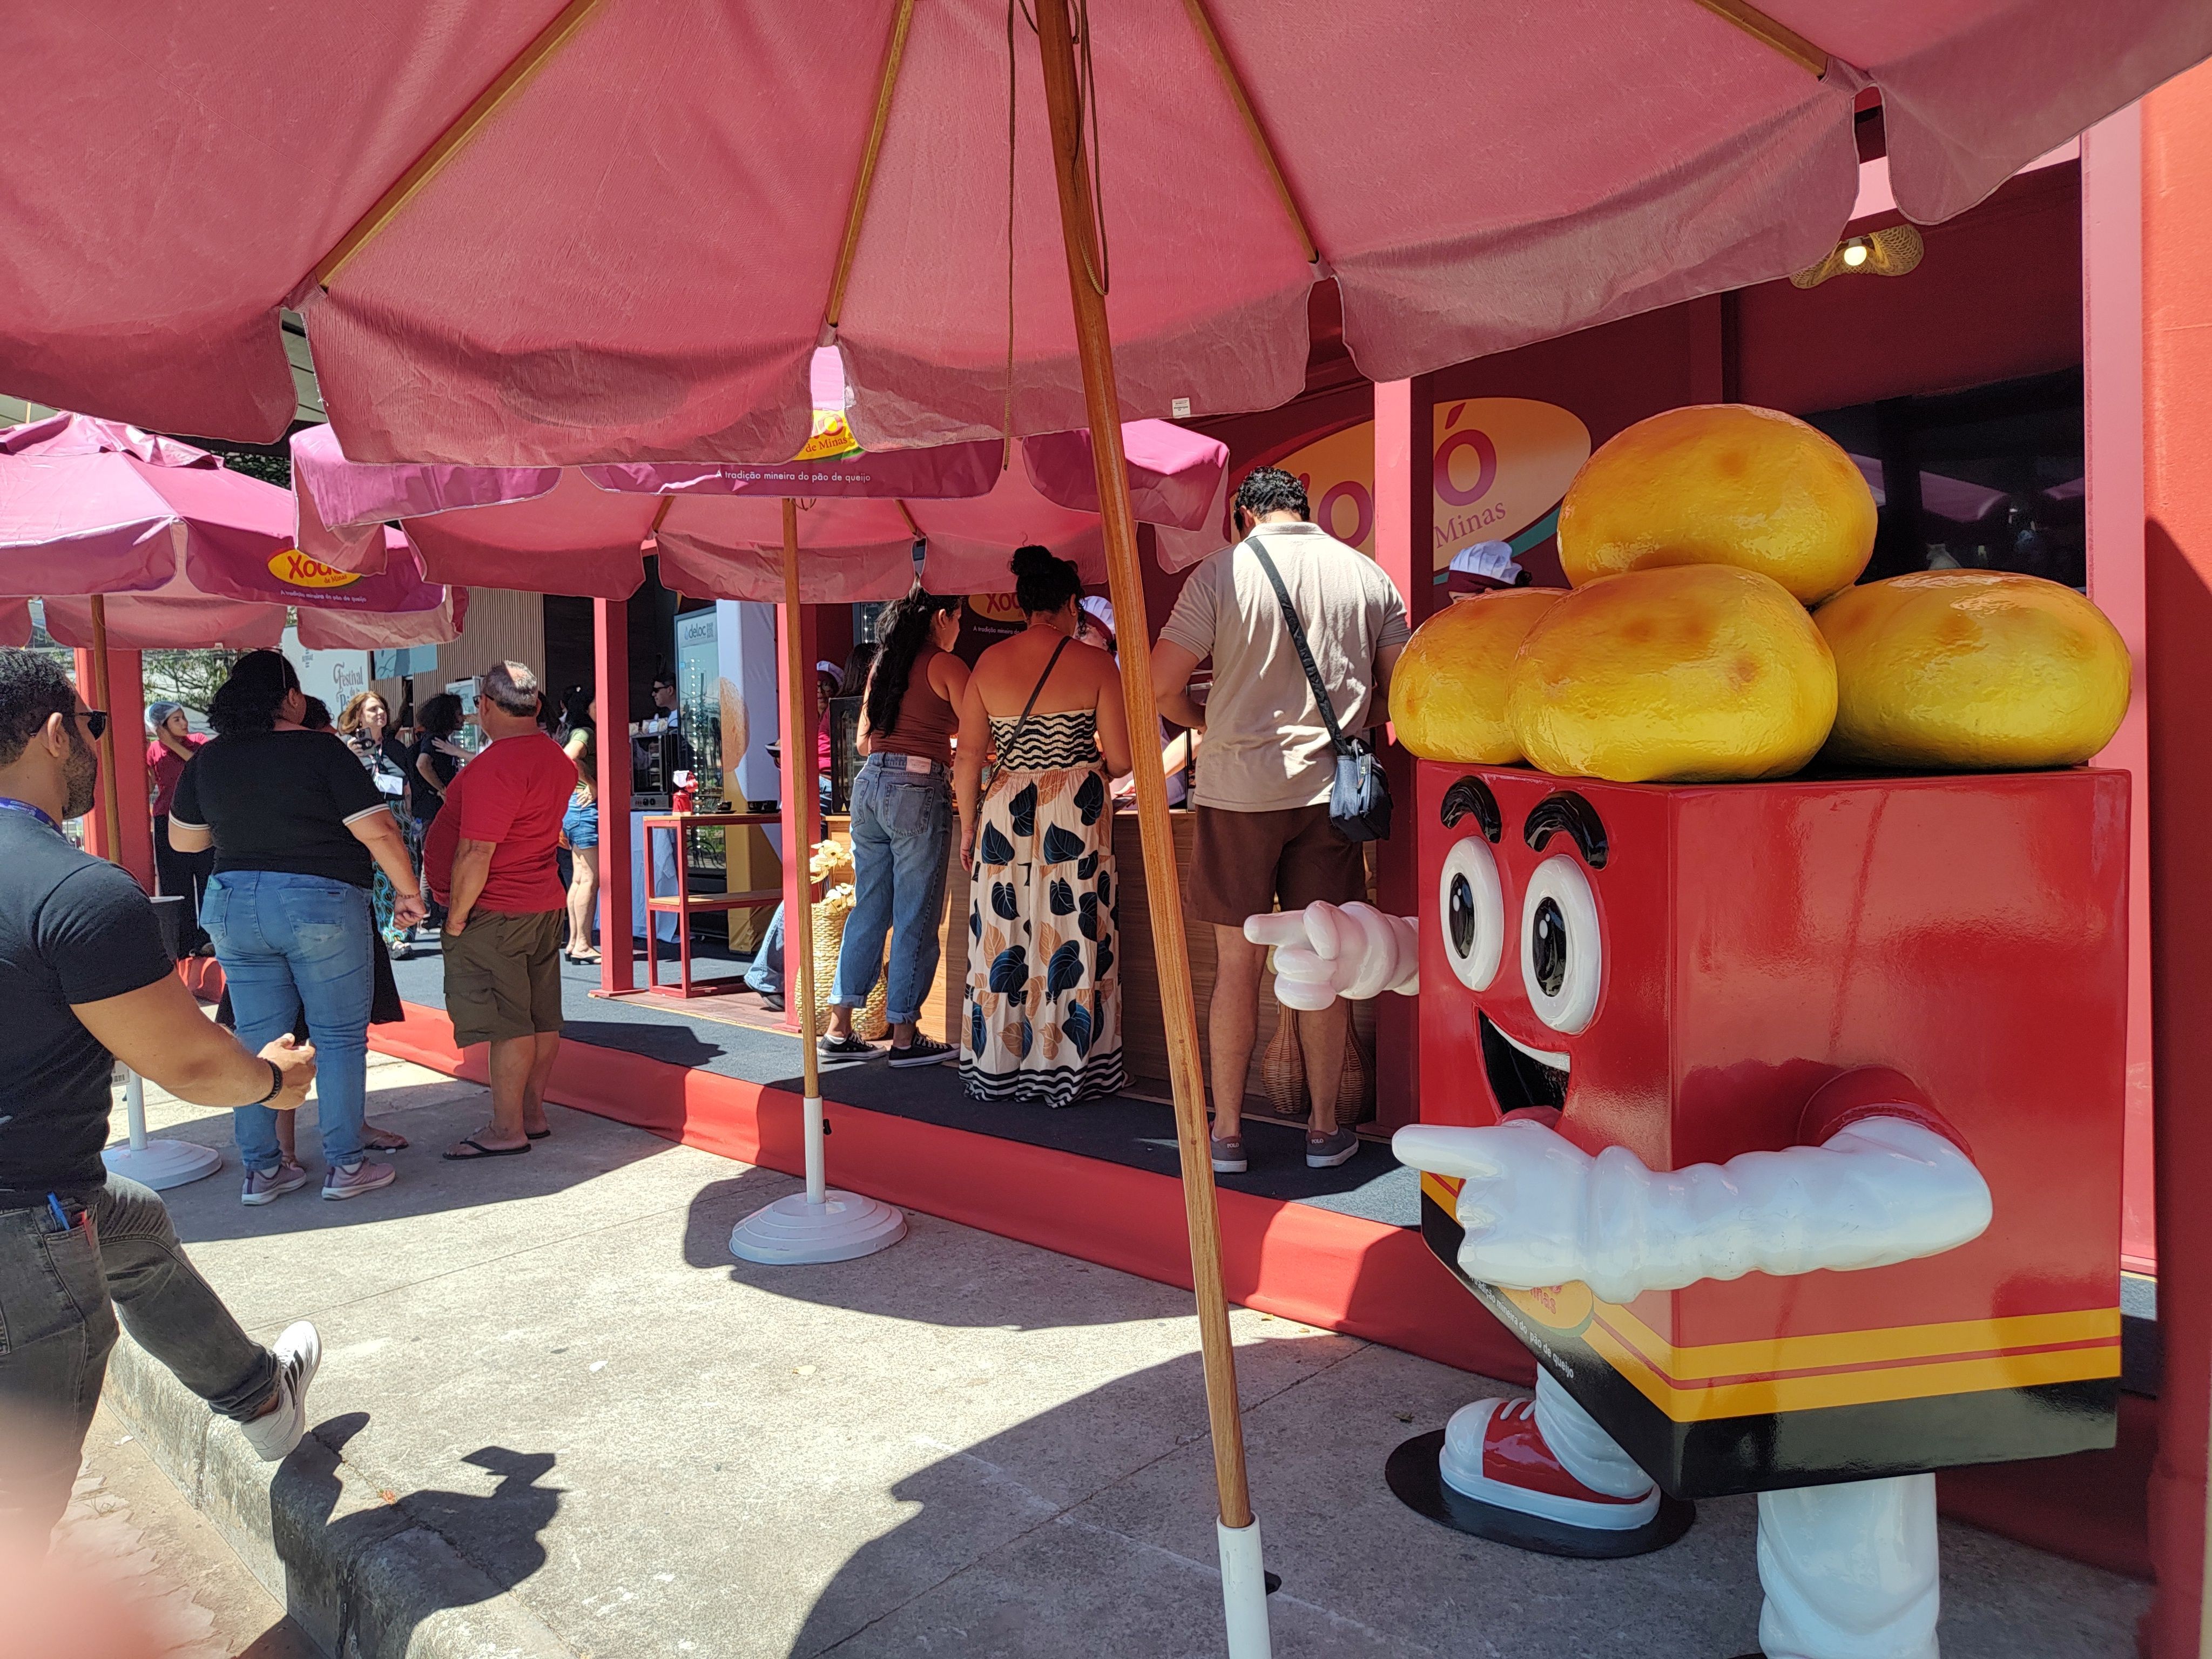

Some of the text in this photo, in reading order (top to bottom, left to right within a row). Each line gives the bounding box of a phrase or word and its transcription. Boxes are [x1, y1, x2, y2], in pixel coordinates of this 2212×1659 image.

[805, 436, 847, 453] de Minas
[716, 470, 722, 478] A
[725, 470, 761, 482] tradição
[764, 471, 795, 480] mineira
[798, 472, 809, 481] do
[812, 473, 828, 483] pão
[845, 474, 871, 483] queijo
[1434, 502, 1506, 549] Minas
[689, 623, 706, 638] deloc
[333, 661, 363, 690] Festival
[1474, 1279, 1574, 1378] tradição mineira do pão de queijo
